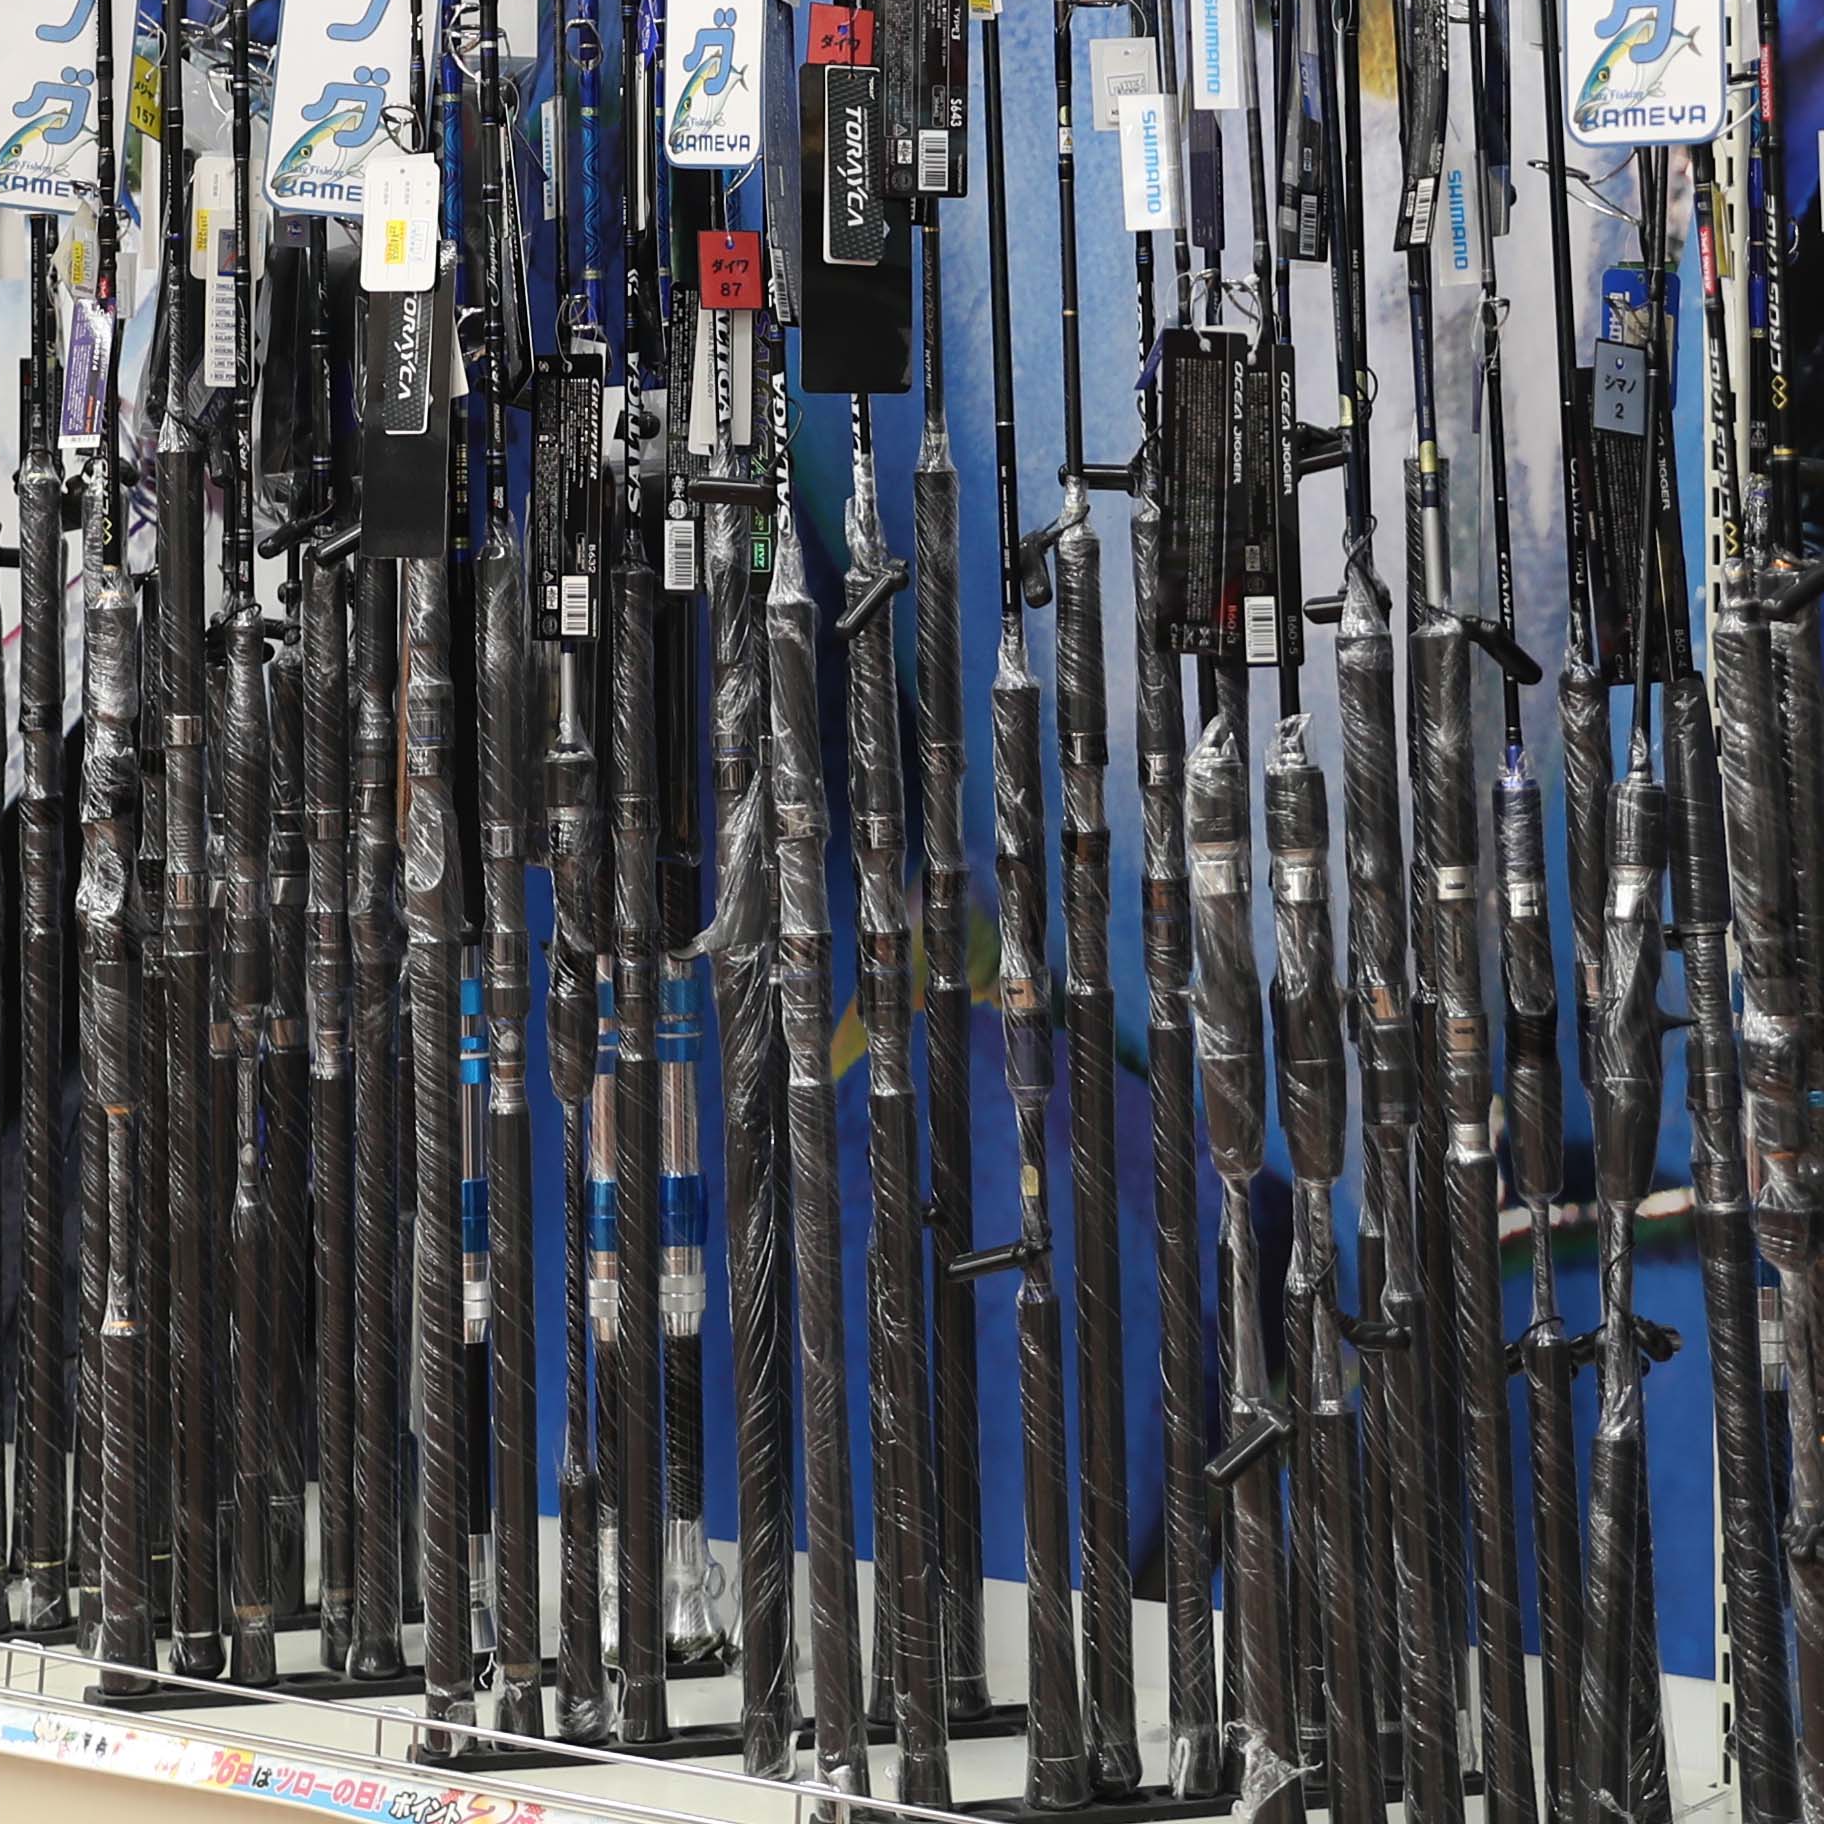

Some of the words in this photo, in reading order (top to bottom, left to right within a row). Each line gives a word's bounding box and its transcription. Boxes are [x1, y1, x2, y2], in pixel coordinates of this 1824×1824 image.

[133, 79, 160, 99] メジャ
[135, 104, 157, 127] 157
[949, 97, 964, 128] S643
[1581, 103, 1706, 128] KAMEYA
[675, 133, 752, 153] KAMEYA
[1141, 109, 1163, 216] SHIMANO
[279, 177, 364, 203] KAME
[1447, 169, 1468, 272] SHIMANO
[711, 257, 749, 275] ダイワ
[720, 281, 743, 298] 87
[397, 291, 418, 403] ORAYCA
[1232, 360, 1245, 421] OCEA
[1280, 370, 1293, 431] OCEA
[1604, 377, 1638, 394] シマノ
[1614, 402, 1625, 420] 2
[589, 376, 601, 481] GRAPPLER
[625, 350, 642, 518] SALTIGA
[1232, 427, 1245, 486] JIGGER
[1282, 435, 1293, 497] JIGGER
[587, 542, 598, 575] B632
